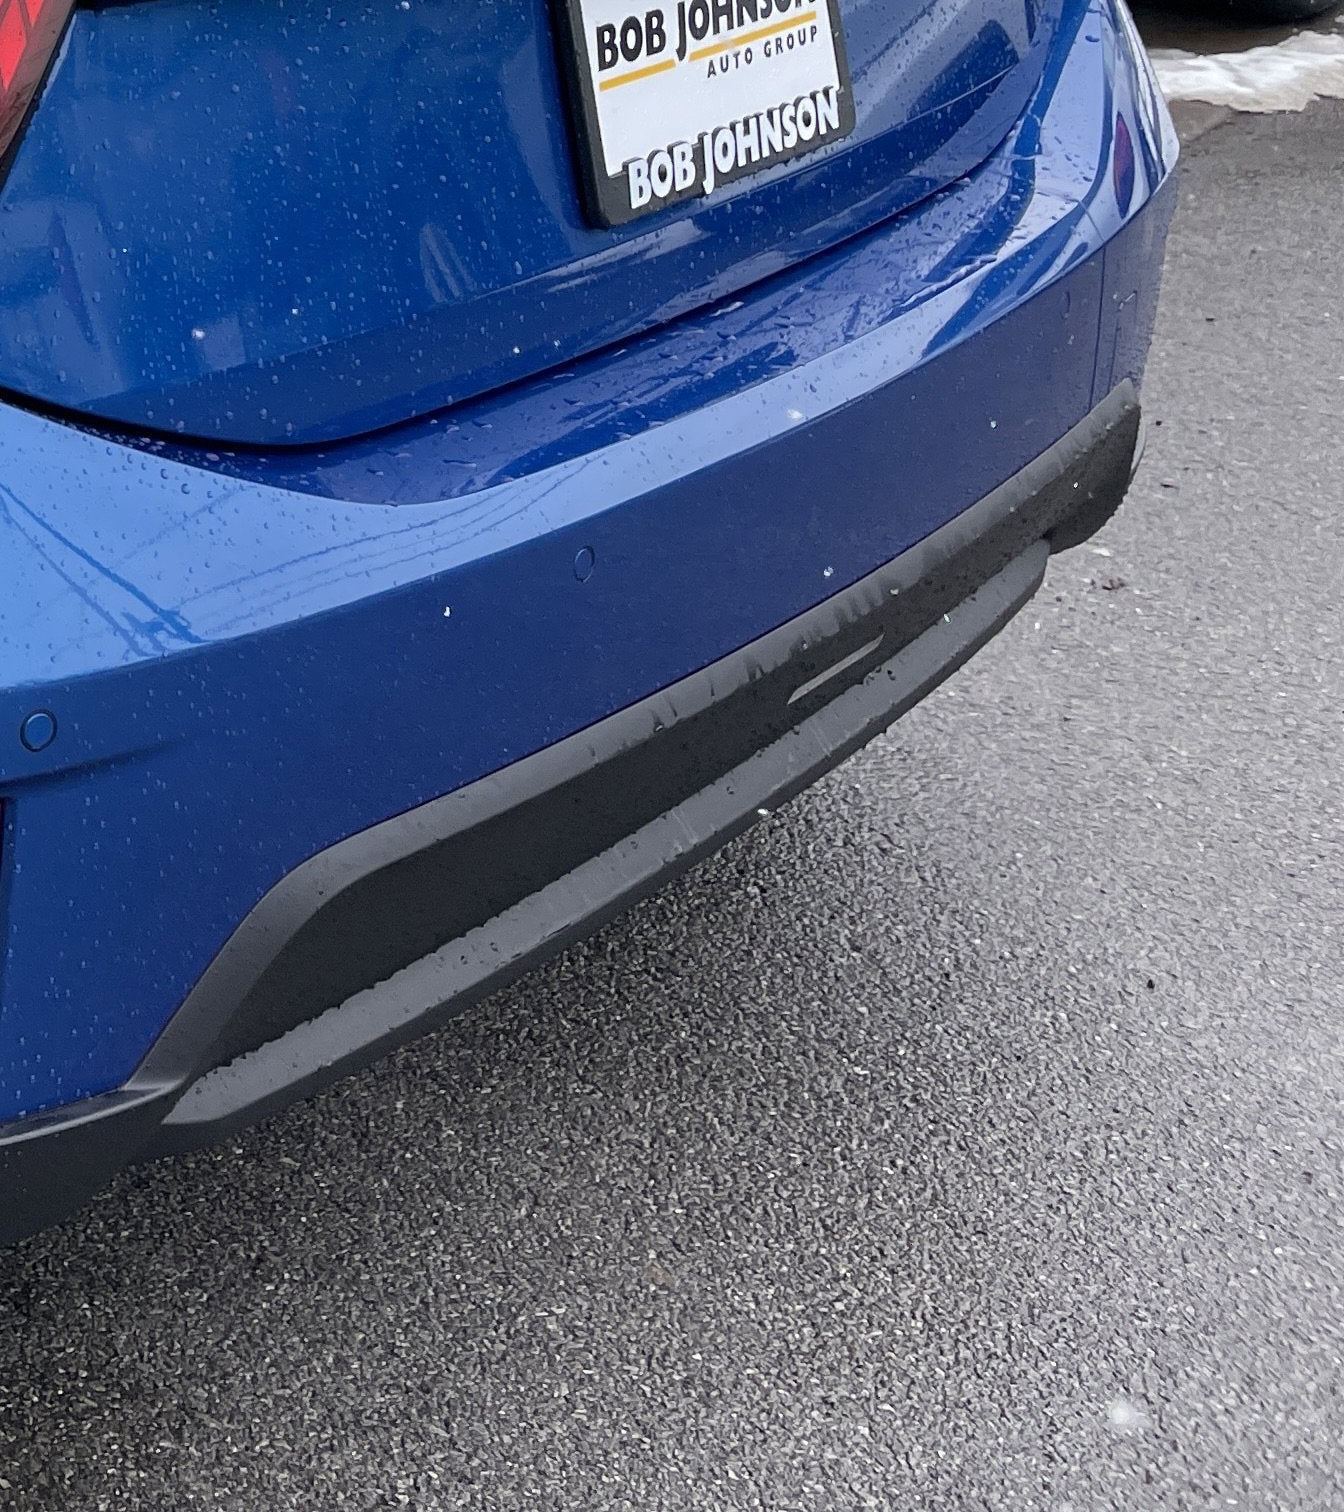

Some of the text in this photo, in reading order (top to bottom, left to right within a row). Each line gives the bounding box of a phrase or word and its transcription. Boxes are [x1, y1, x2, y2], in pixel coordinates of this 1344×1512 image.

[595, 9, 666, 73] BOB
[707, 25, 819, 79] AUTO GROUP
[625, 86, 841, 210] BOB JOHNSON
